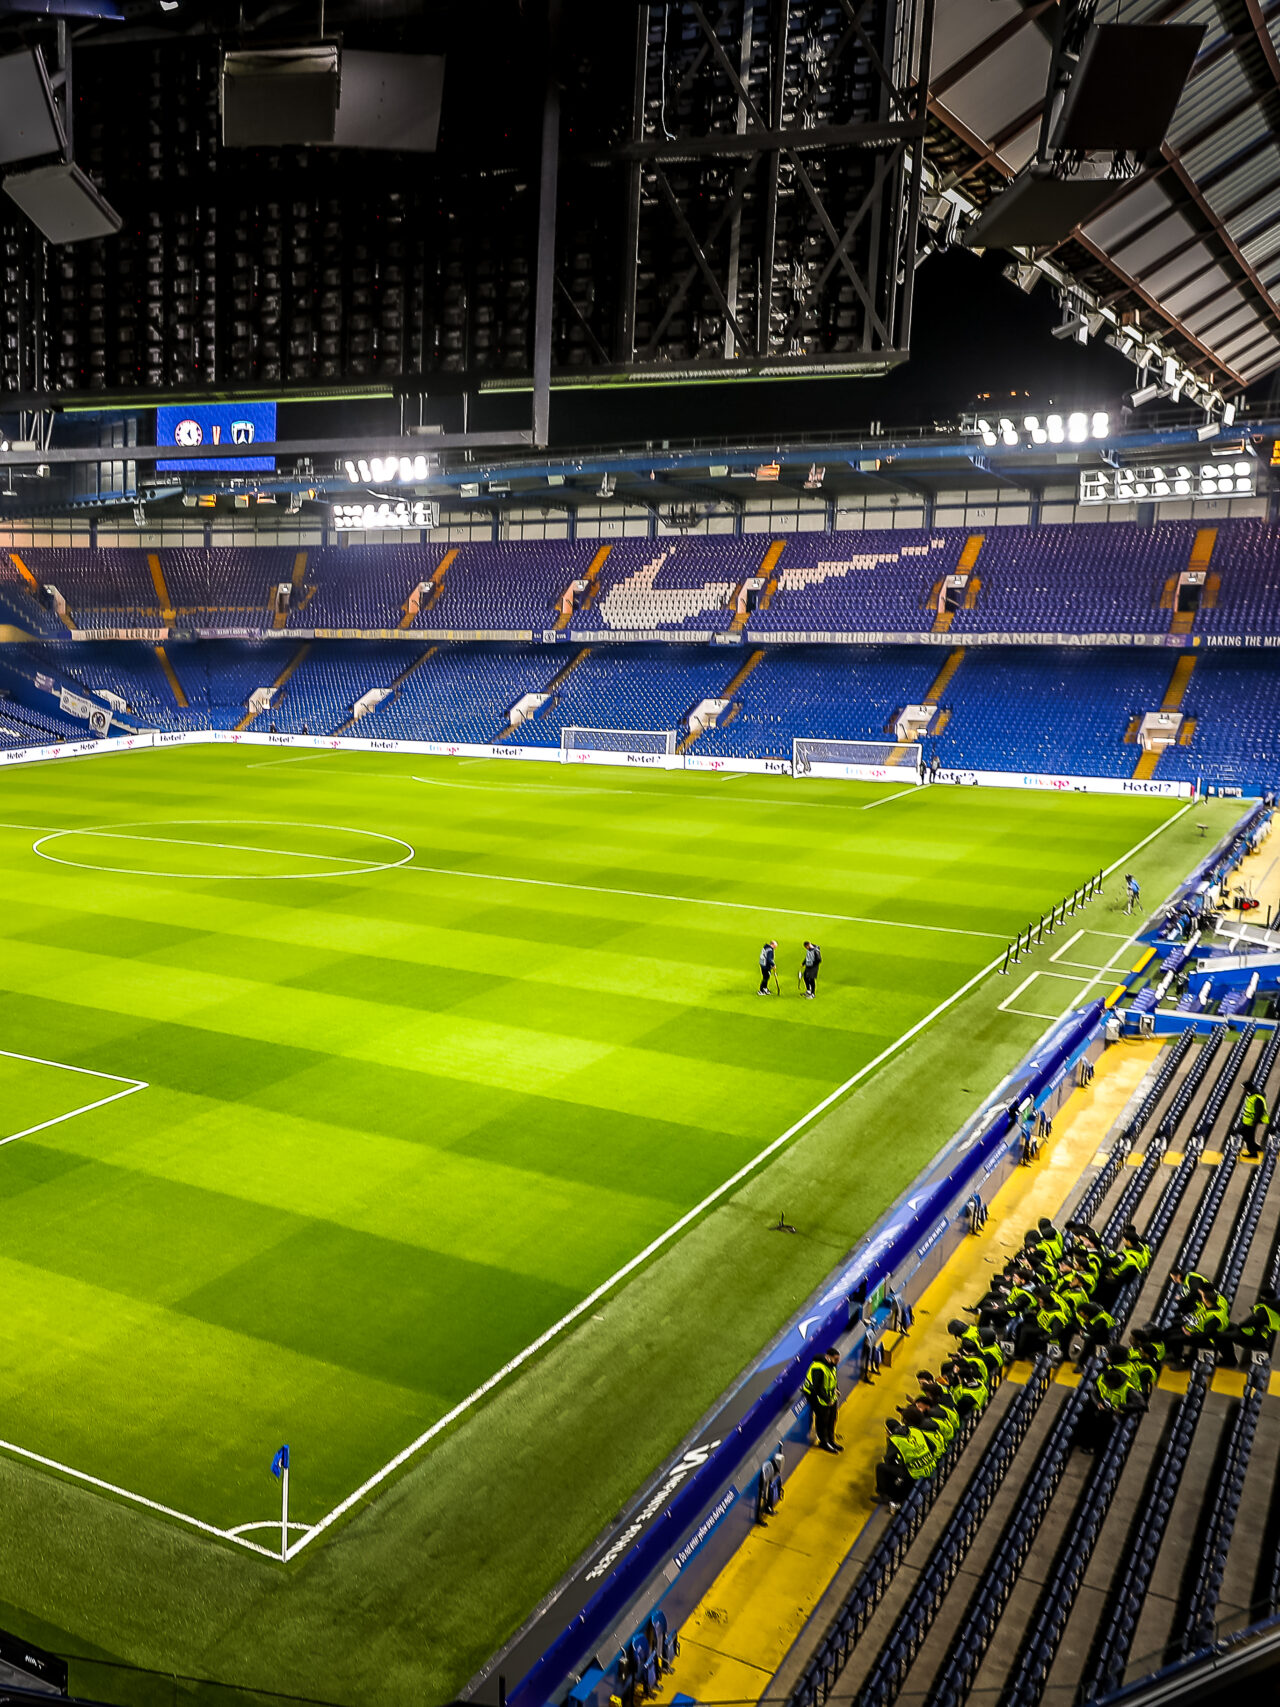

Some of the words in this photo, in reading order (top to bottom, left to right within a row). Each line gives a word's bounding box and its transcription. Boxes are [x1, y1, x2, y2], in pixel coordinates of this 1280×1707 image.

[763, 632, 807, 642] CHELSEA
[810, 632, 831, 642] OUR
[835, 632, 884, 642] RELIGION
[920, 633, 974, 645] SUPER
[977, 632, 1054, 645] FRANKIE
[1057, 632, 1146, 646] LAMPARD
[1207, 635, 1242, 647] TAKING
[1244, 636, 1262, 647] THE
[1263, 636, 1280, 647] MI
[1023, 775, 1071, 791] trivago
[1122, 781, 1173, 794] Hotel?
